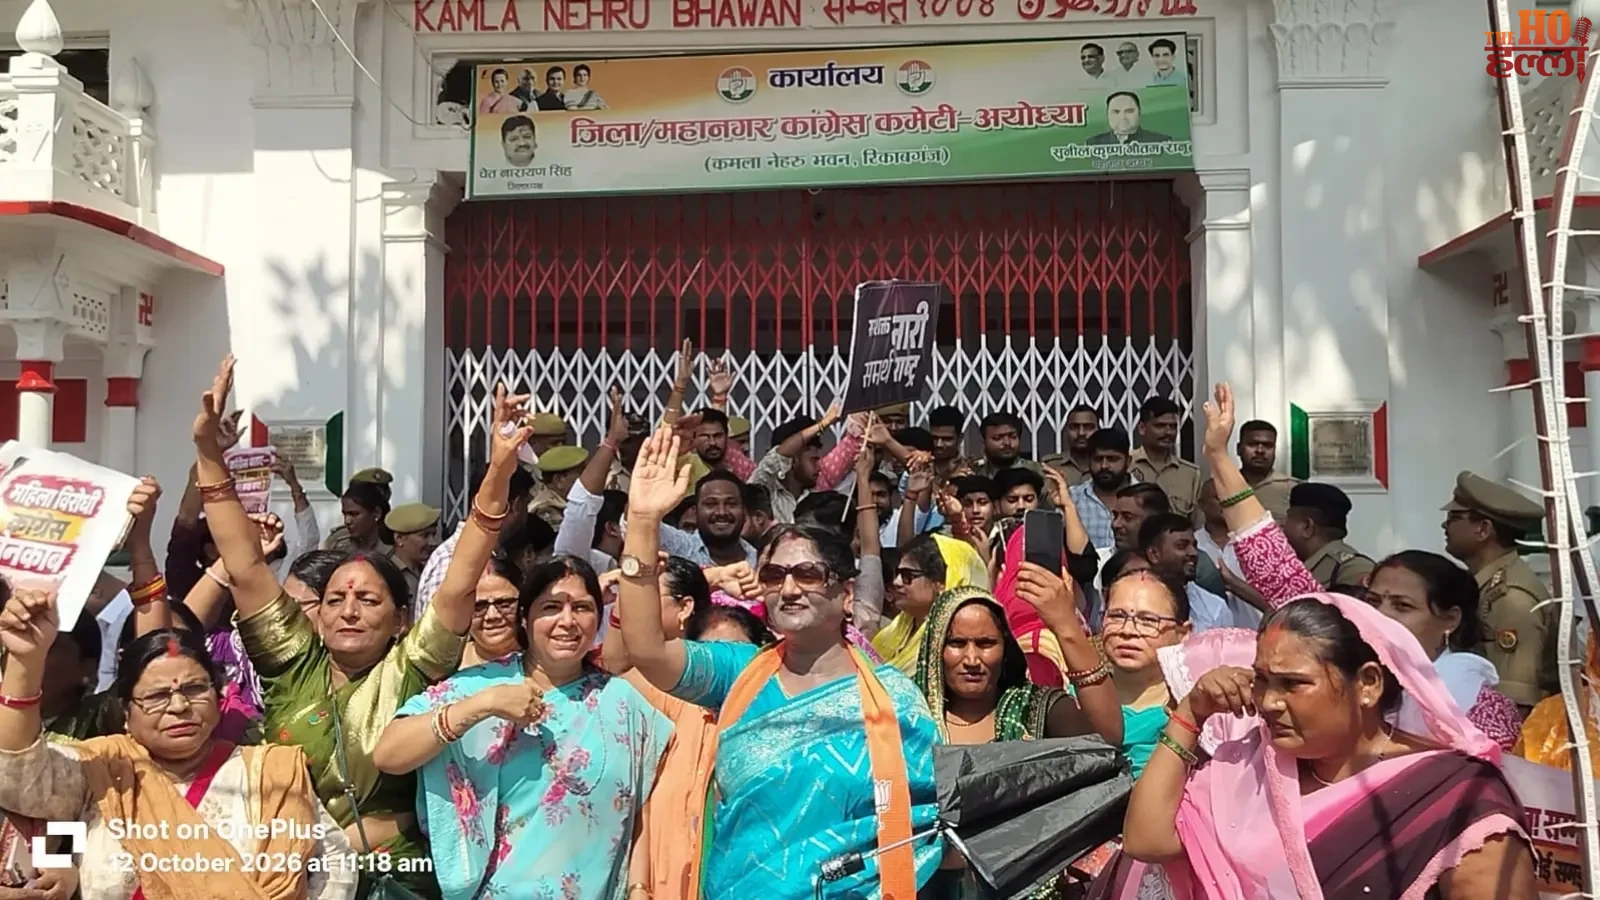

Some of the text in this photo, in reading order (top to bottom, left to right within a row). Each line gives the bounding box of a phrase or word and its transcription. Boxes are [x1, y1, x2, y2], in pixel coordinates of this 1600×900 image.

[414, 0, 801, 32] KAMLA NEHRU BHAWAN
[769, 62, 885, 88] कार्यालय
[571, 117, 775, 147] जिला/महानगर
[781, 108, 869, 139] कांग्रेस
[705, 155, 761, 172] (कमला
[863, 145, 950, 165] रिकाबगंज)
[1051, 143, 1091, 161] सुनील
[500, 166, 546, 179] नारायण
[891, 300, 929, 350] नारी
[863, 349, 920, 388] समर्थ राष्ट्र
[9, 479, 101, 515] महिला विरोधी
[0, 530, 72, 573] ेनकाब
